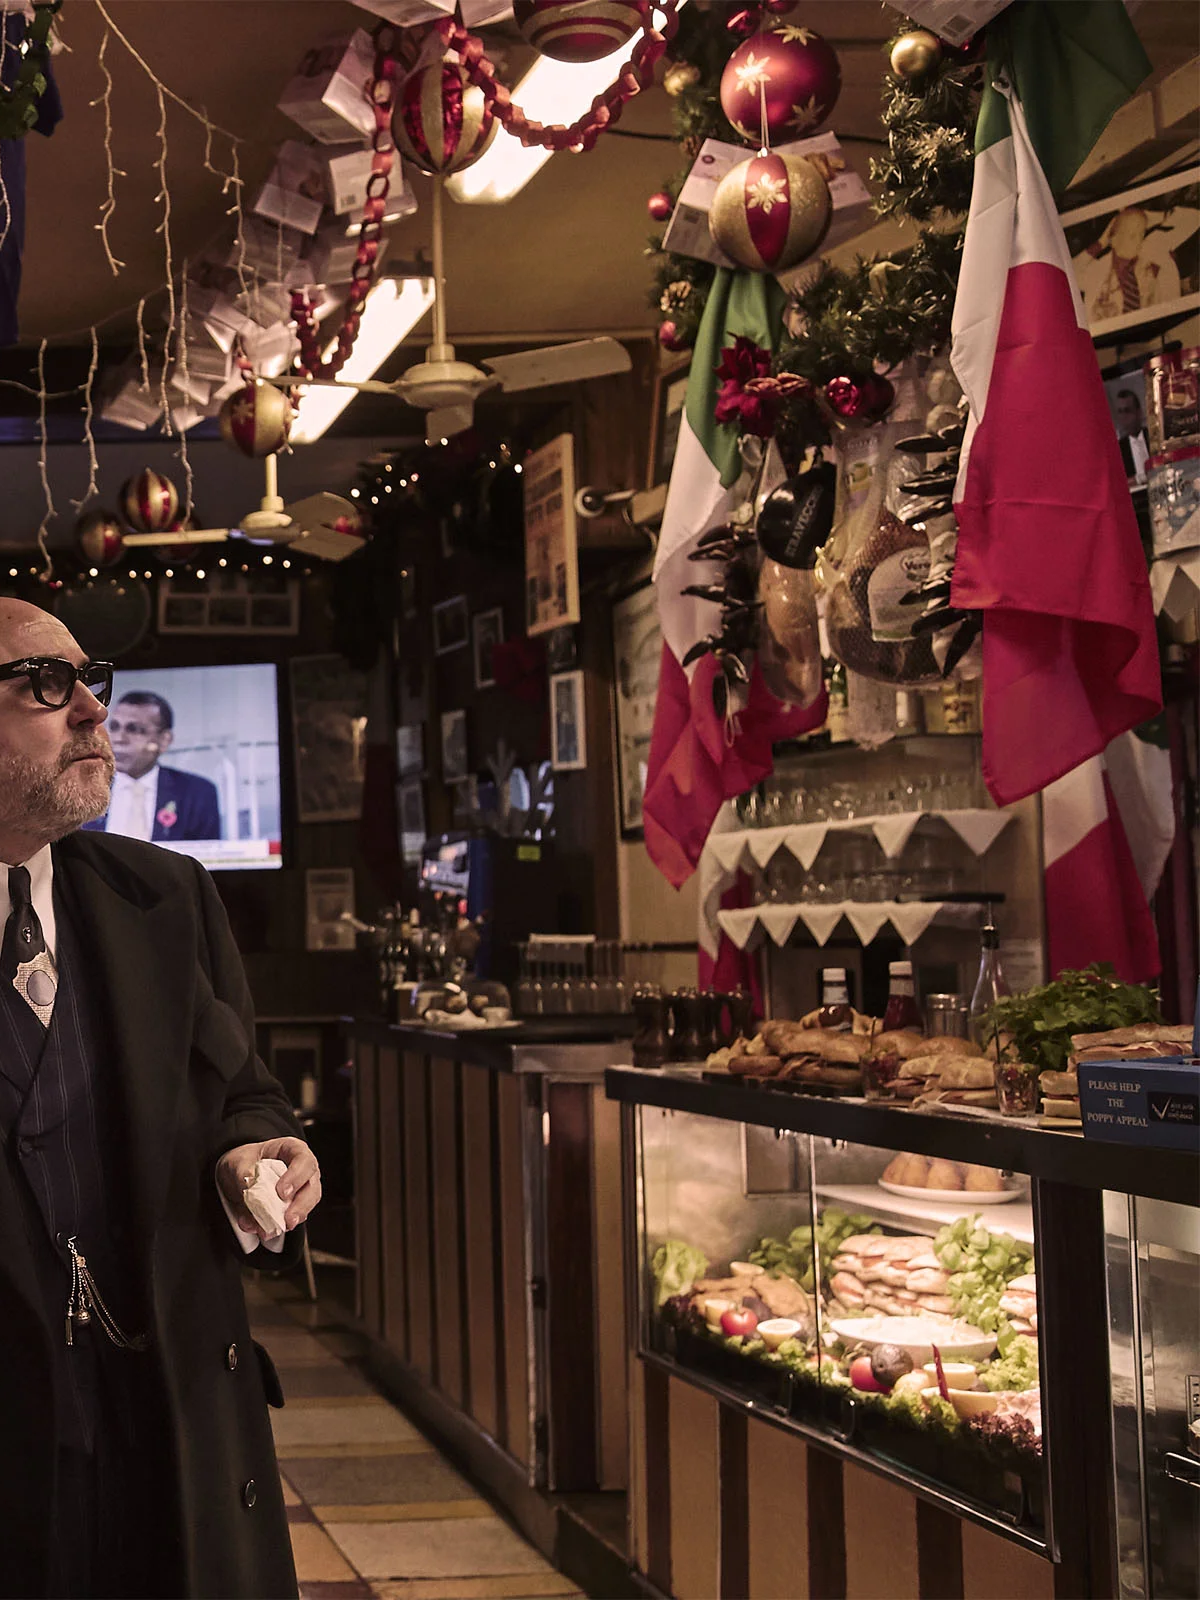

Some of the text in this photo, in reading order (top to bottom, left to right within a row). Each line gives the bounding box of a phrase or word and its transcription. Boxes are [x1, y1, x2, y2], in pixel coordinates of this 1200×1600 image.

[1088, 1080, 1141, 1093] PLEASE HELP
[1107, 1098, 1125, 1108] THE
[1087, 1112, 1148, 1127] POPPY APPEAL
